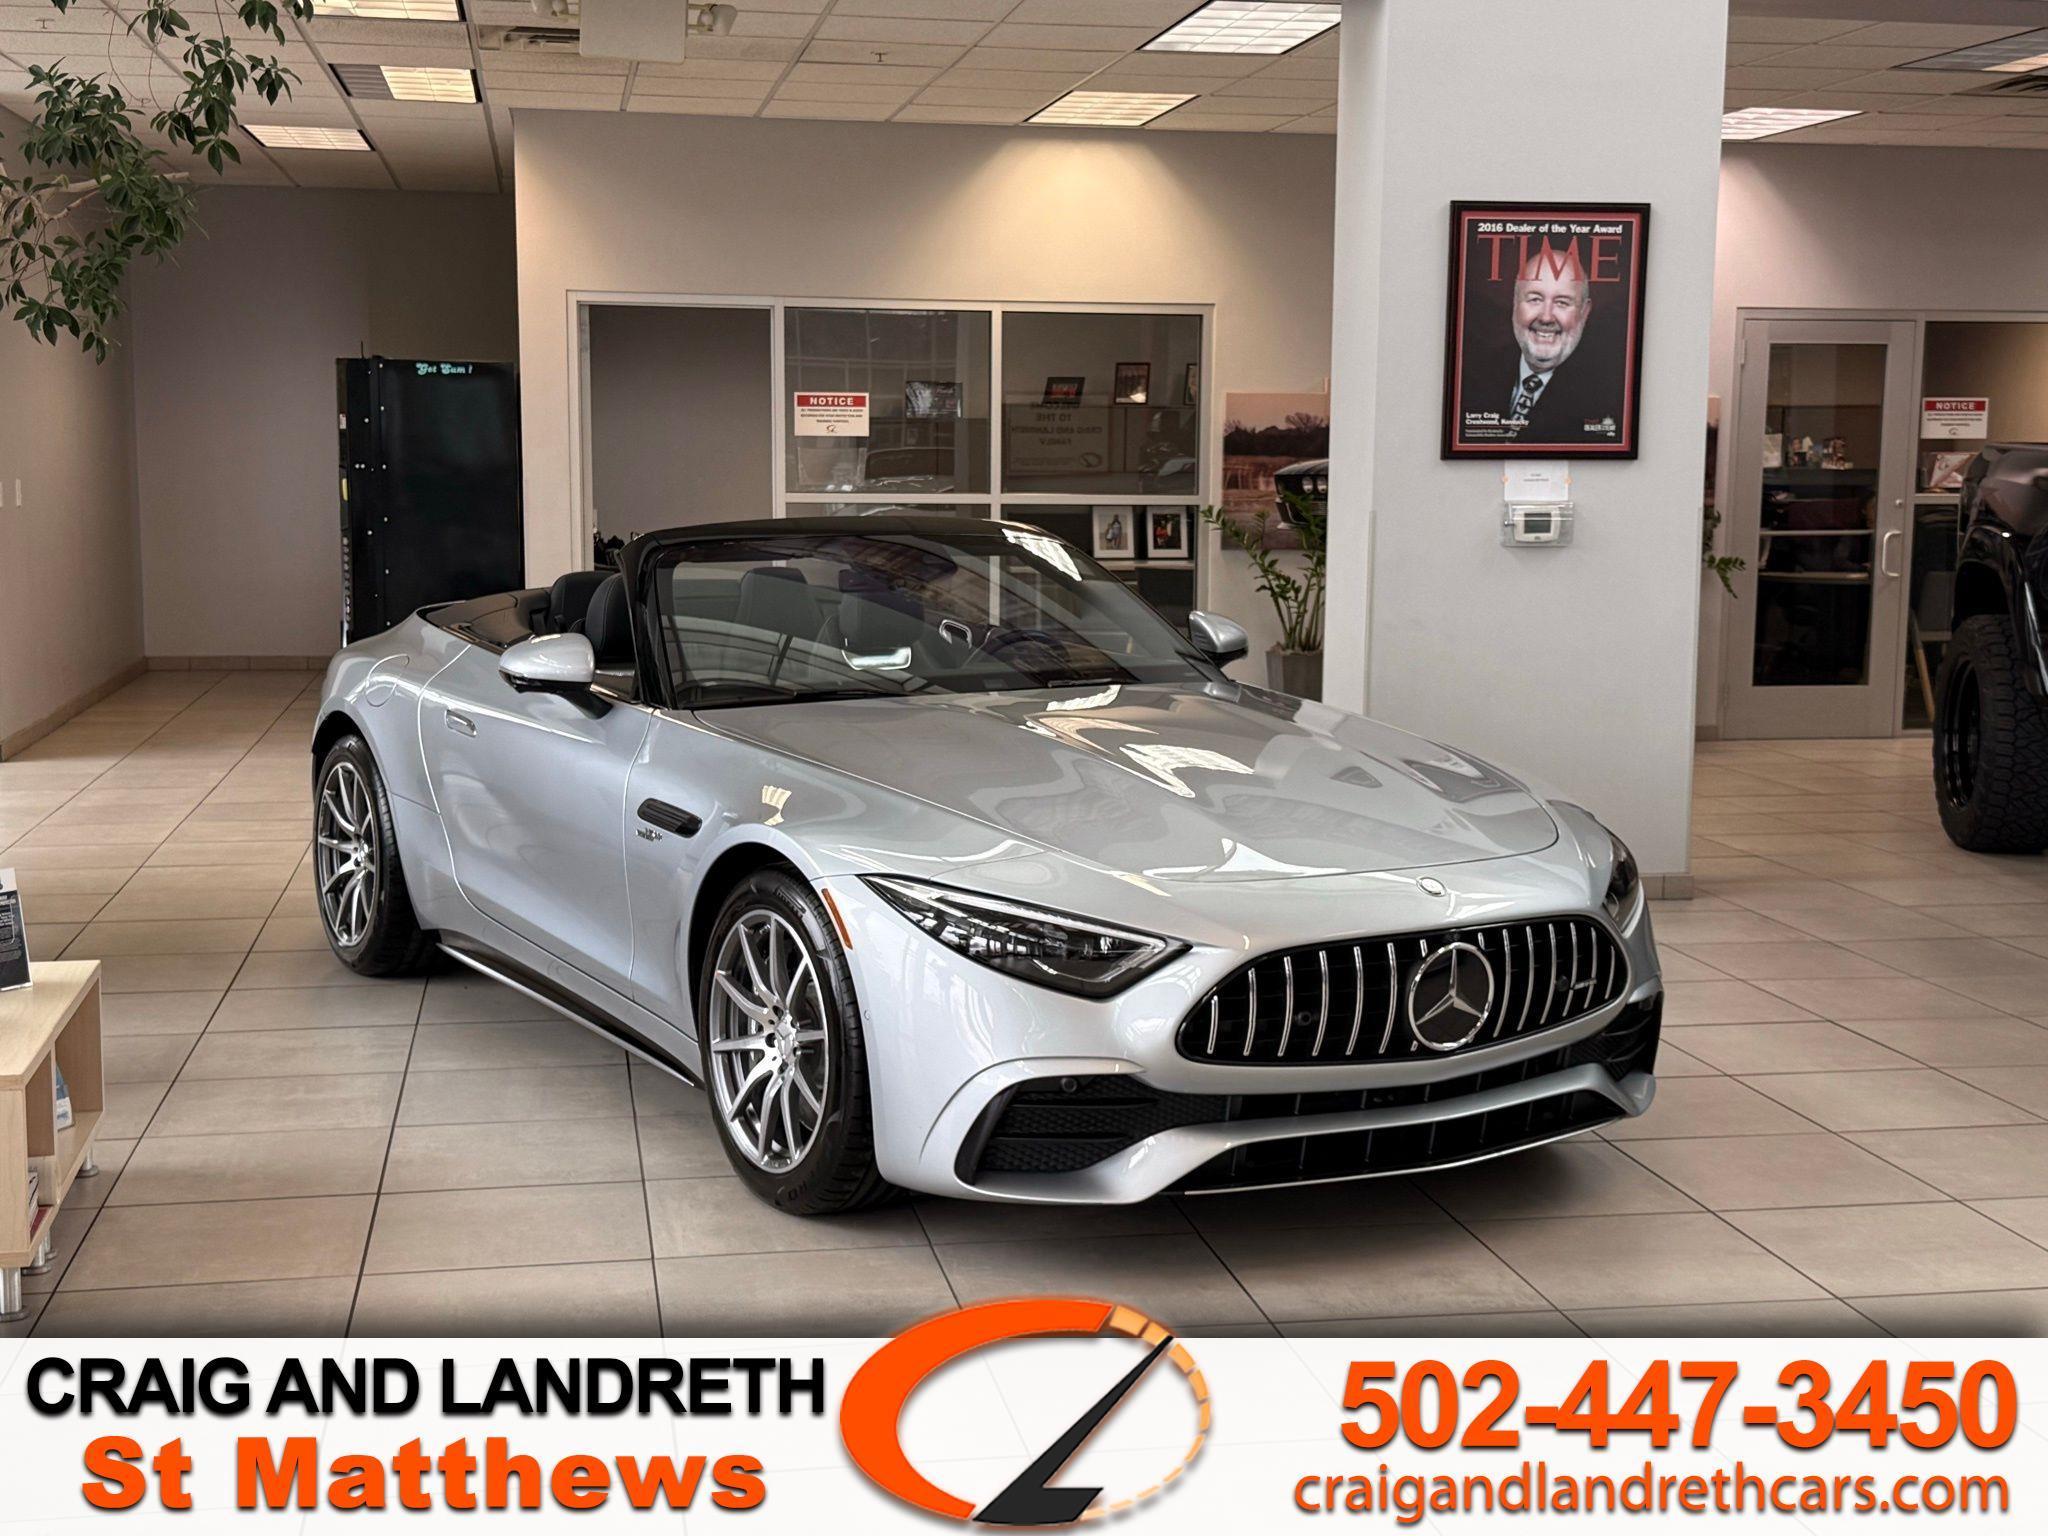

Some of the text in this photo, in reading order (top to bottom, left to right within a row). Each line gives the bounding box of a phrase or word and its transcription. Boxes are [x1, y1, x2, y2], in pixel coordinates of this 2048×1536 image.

[1477, 223, 1623, 234] 2016 Dealer of the Year Award
[1476, 234, 1622, 282] TIME
[809, 396, 854, 406] NOTICE
[1935, 401, 1976, 410] NOTICE
